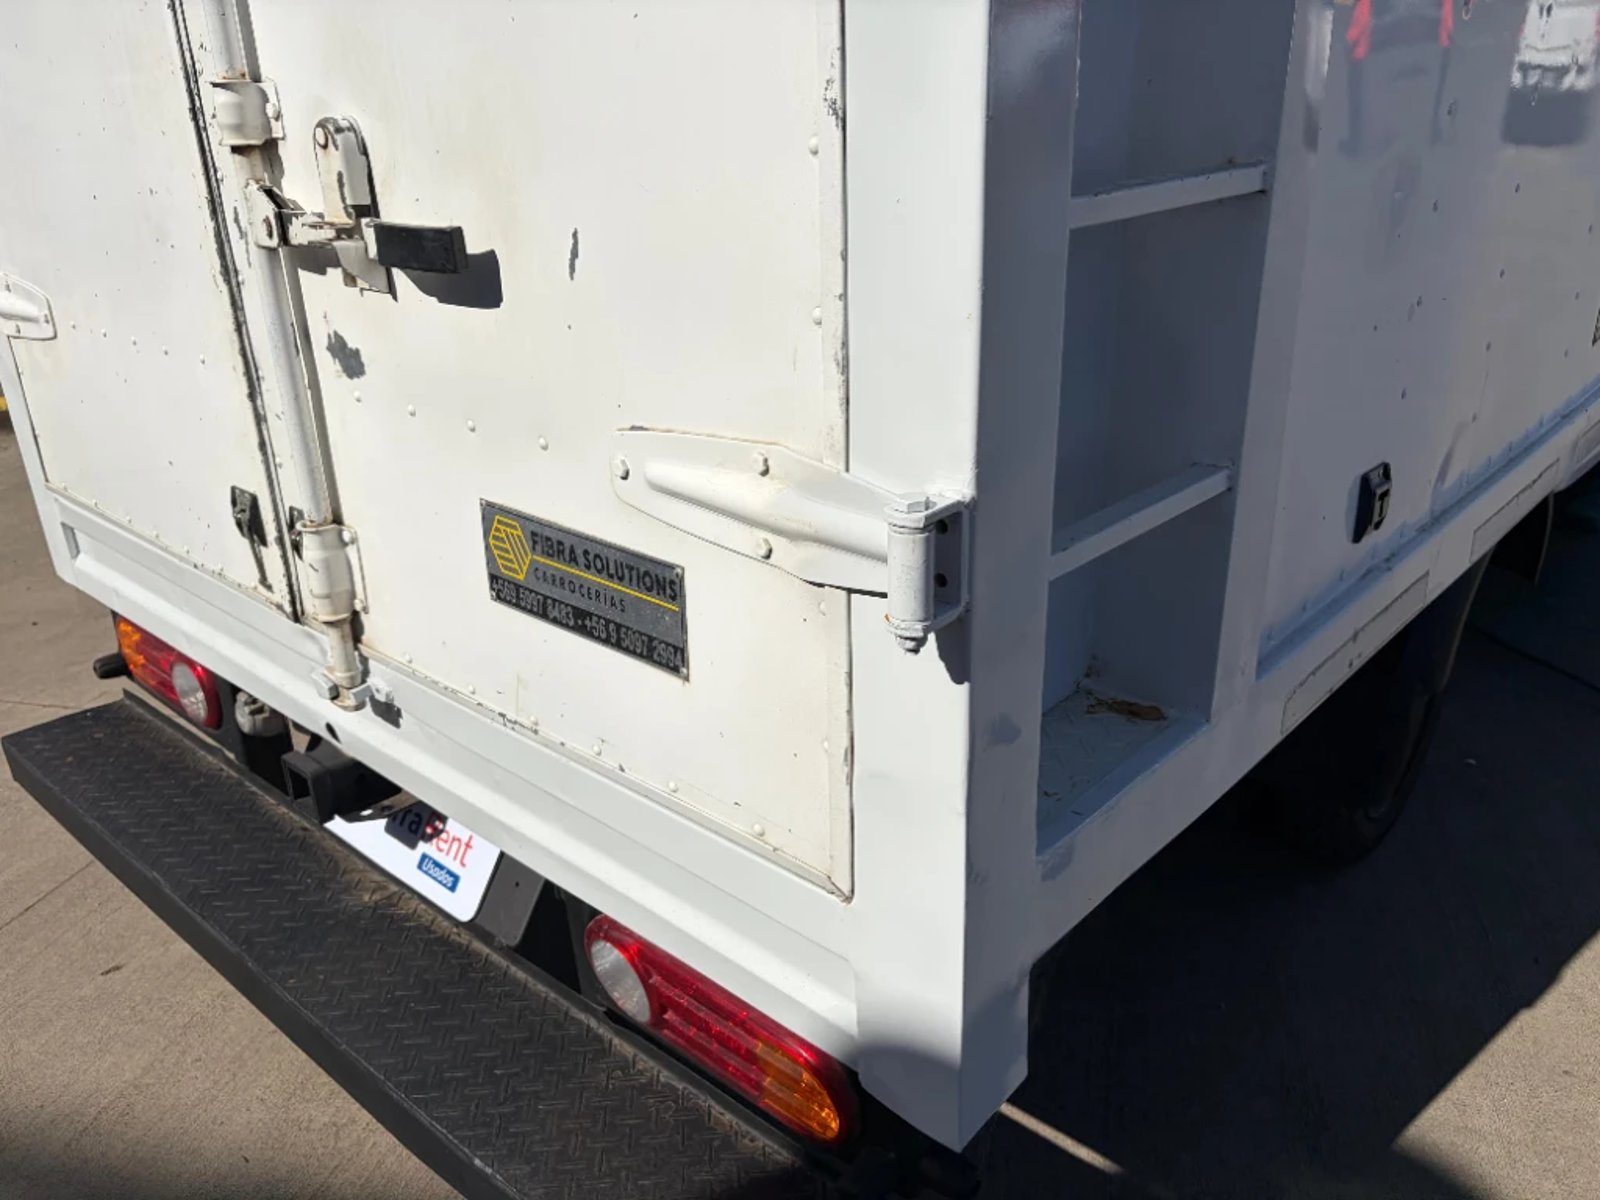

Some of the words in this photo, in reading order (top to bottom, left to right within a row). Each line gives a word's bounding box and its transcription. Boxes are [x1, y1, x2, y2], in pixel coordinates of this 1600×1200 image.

[530, 531, 579, 566] FIBRA
[583, 548, 679, 601] SOLUTIONS
[421, 858, 454, 888] Usados
